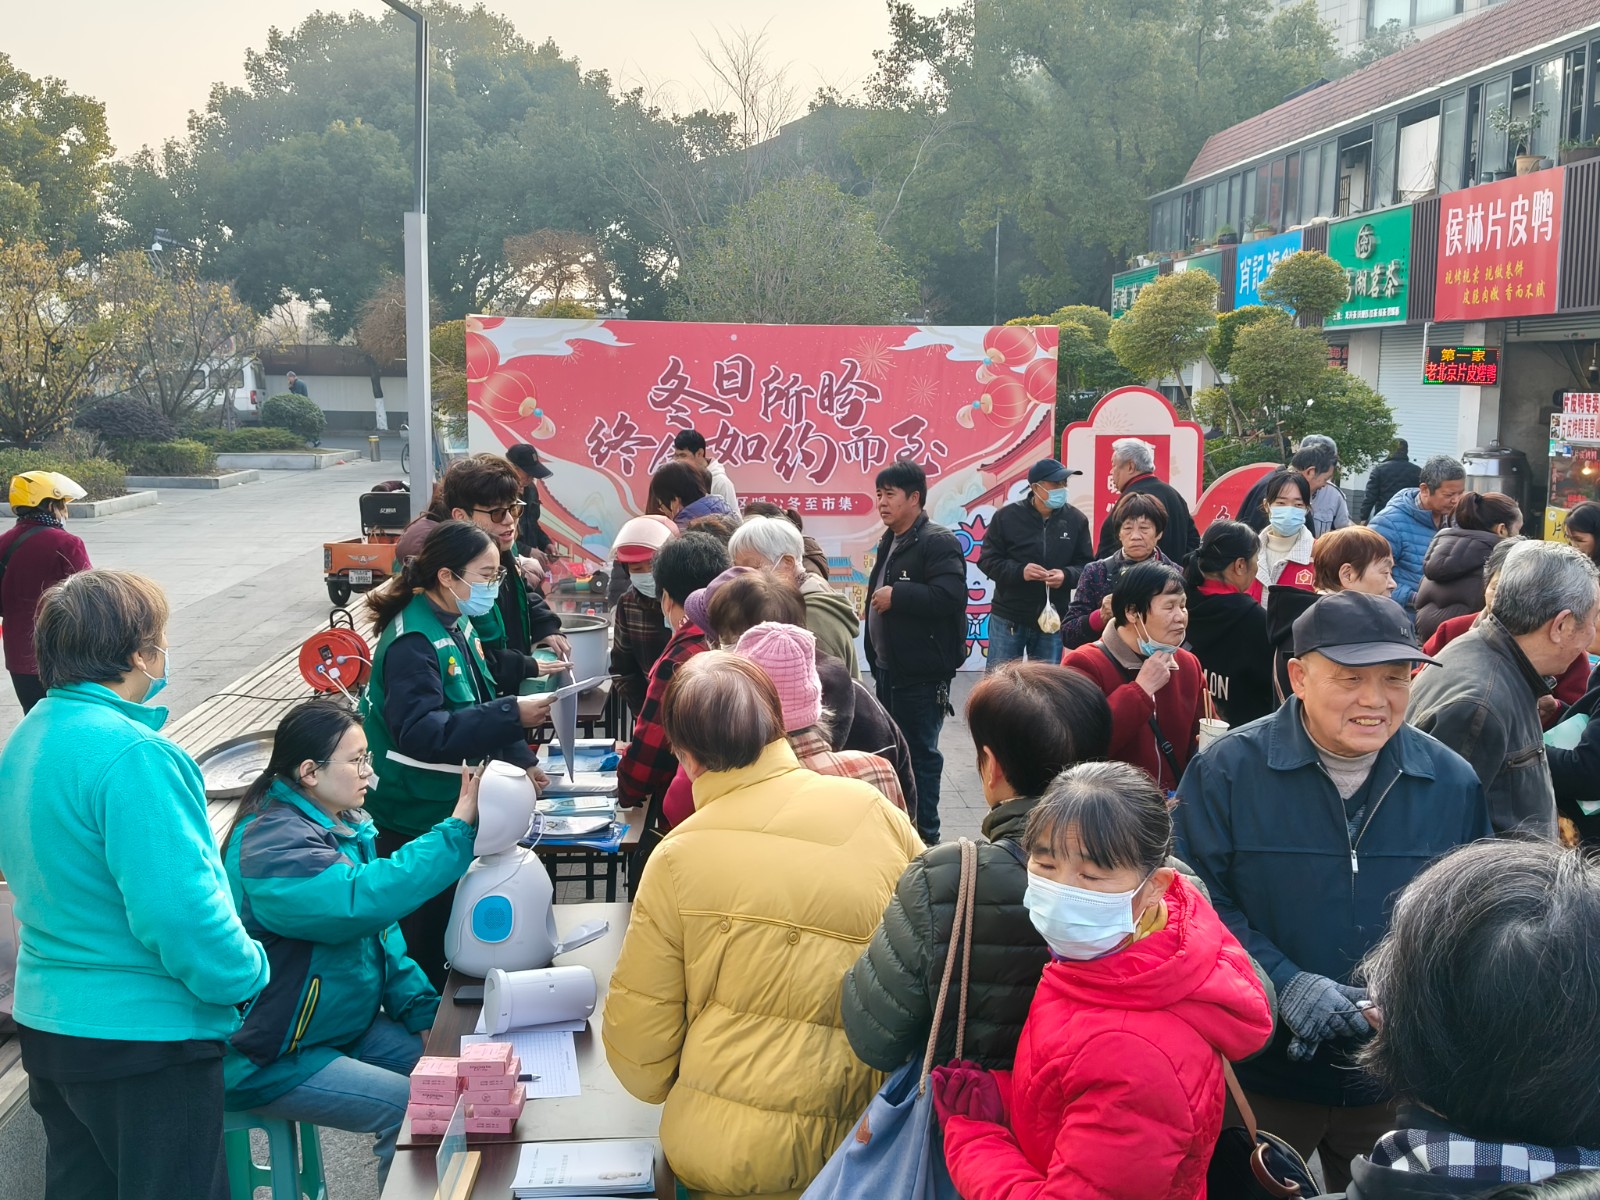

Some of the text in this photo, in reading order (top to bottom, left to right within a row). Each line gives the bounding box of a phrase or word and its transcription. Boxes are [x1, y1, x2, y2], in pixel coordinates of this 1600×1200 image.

[1445, 188, 1554, 256] 侯林片皮鸭
[1441, 348, 1486, 361] 第一家
[1425, 362, 1497, 382] 老北京片皮烤鸭
[648, 354, 882, 429] 冬日所盼
[1562, 418, 1600, 440] 片皮烤鸭直营
